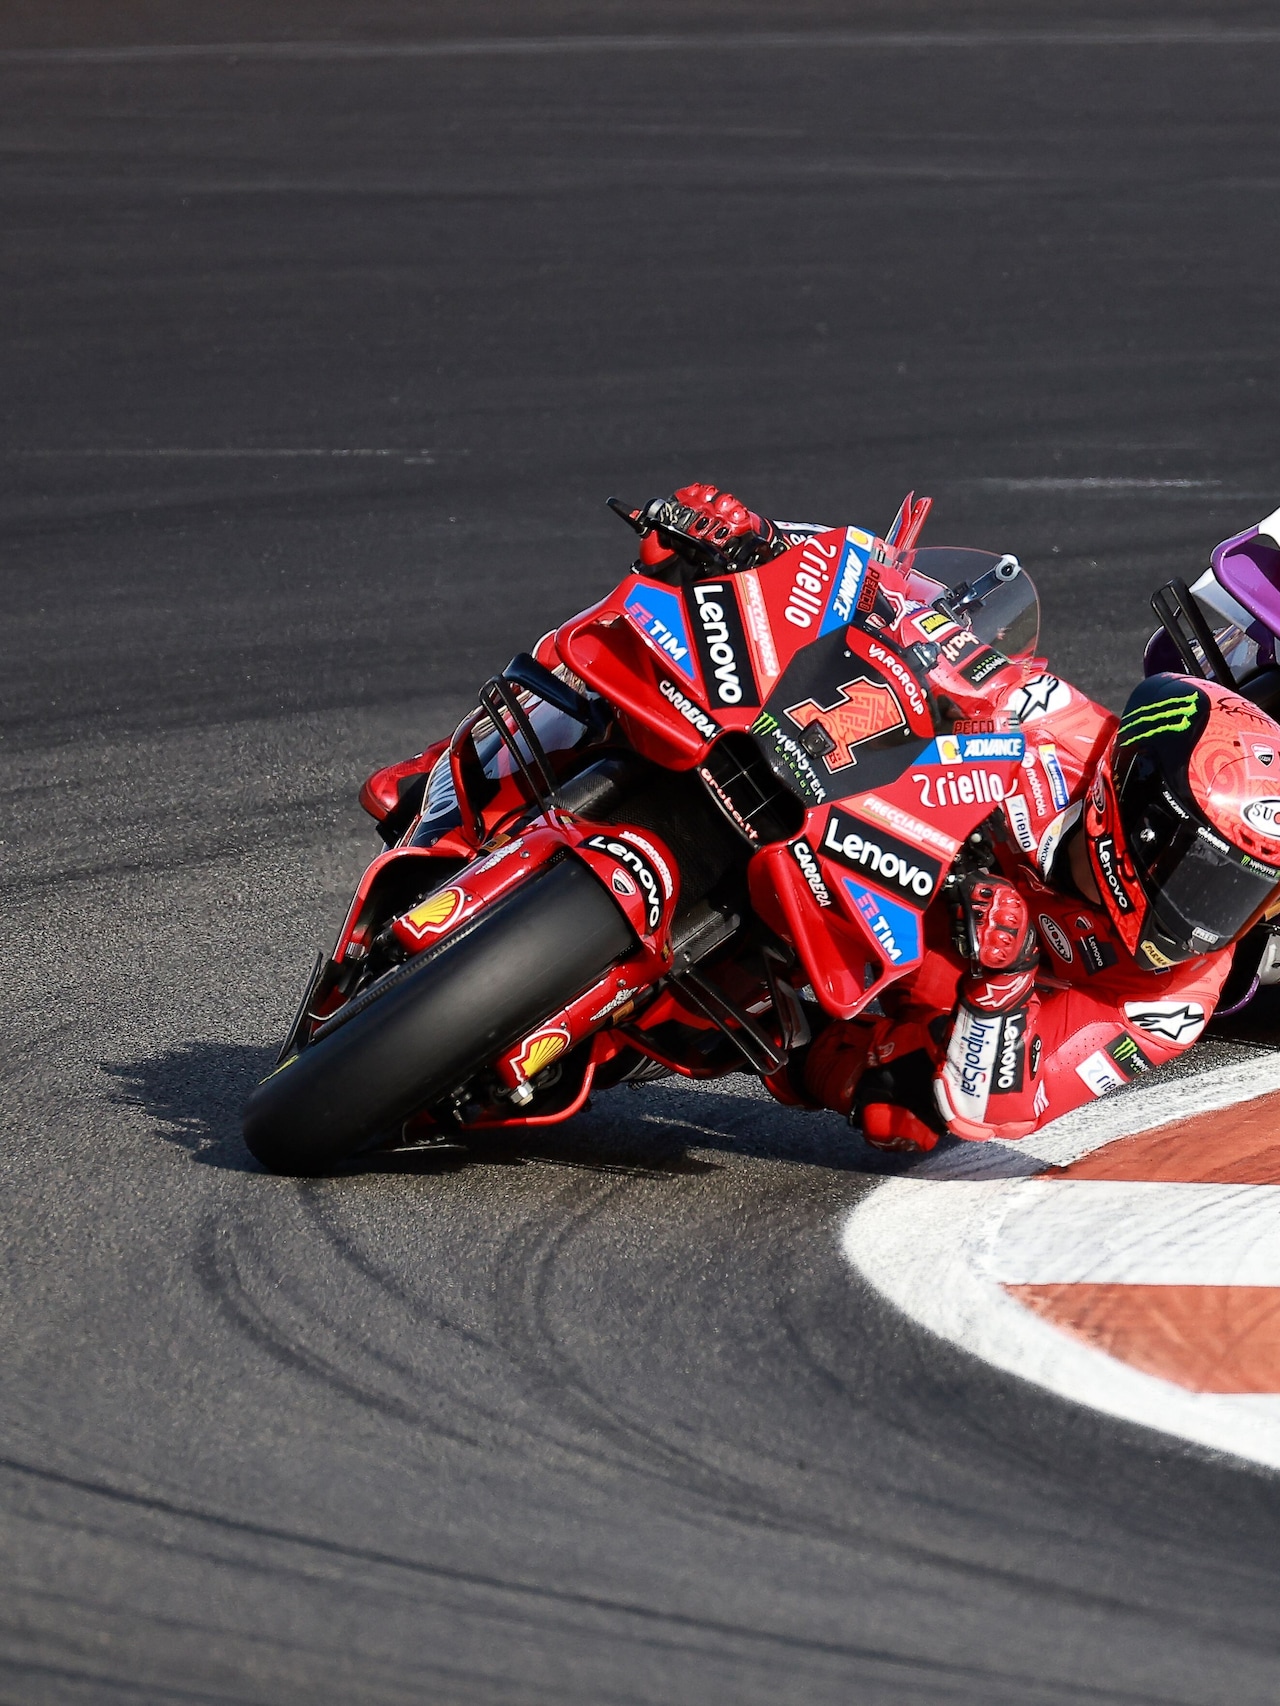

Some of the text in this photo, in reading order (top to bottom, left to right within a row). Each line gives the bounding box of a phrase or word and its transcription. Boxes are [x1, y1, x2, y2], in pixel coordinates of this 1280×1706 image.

[650, 619, 689, 661] TIM
[693, 584, 743, 704] Lenovo
[659, 679, 716, 738] CARRERA
[868, 643, 925, 716] VARGROUP
[783, 676, 907, 774] 1
[963, 738, 1023, 758] ADVANCE
[774, 745, 813, 797] ENERGY
[1025, 768, 1048, 816] motorola
[862, 796, 957, 852] FRECCIAROSSA
[588, 835, 660, 928] Lenovo
[793, 841, 832, 909] CARRERA
[824, 817, 934, 897] Lenovo
[1098, 838, 1129, 909] Lenovo
[872, 915, 903, 962] TIM
[1042, 917, 1070, 960] SUOMY
[1087, 935, 1104, 967] Lenovo
[997, 1012, 1023, 1089] Lenovo
